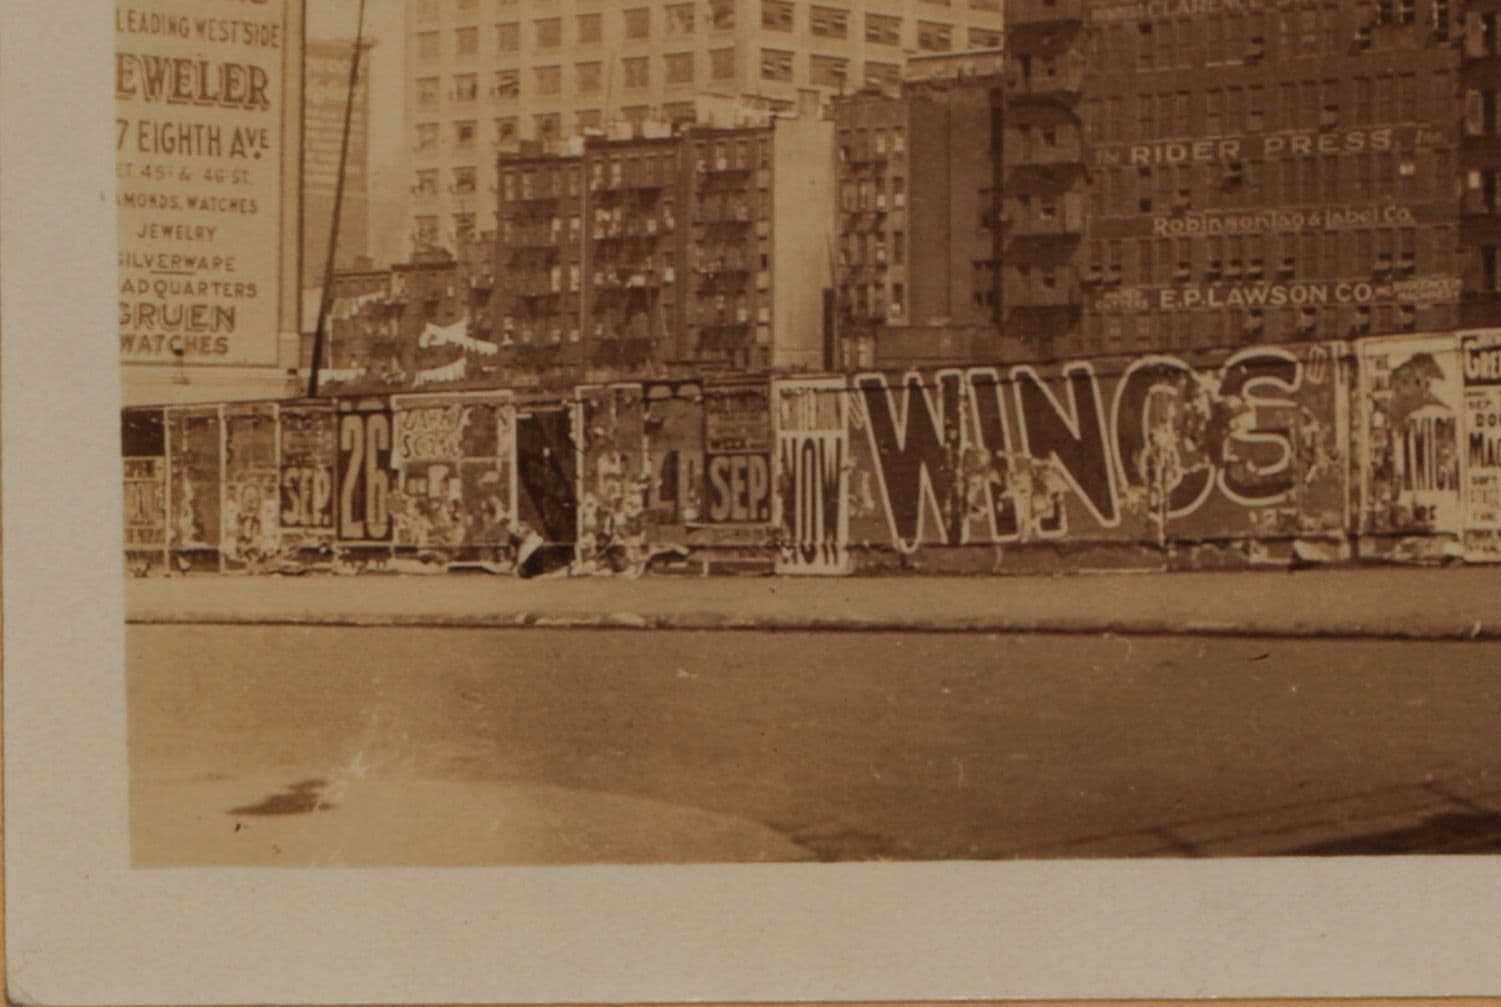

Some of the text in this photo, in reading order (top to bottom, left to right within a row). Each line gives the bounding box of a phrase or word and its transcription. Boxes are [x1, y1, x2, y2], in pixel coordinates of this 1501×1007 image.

[115, 7, 190, 39] LEADING
[116, 52, 271, 112] EWELER
[116, 117, 130, 151] 7
[138, 119, 222, 158] EIGHTH
[1129, 137, 1241, 166] RIDER
[178, 165, 192, 182] &
[186, 194, 259, 215] WATCHES
[1309, 209, 1322, 228] &
[136, 223, 217, 242] JEWELRY
[119, 332, 231, 358] WATCHES
[340, 413, 391, 540] 26
[709, 455, 769, 522] SEP.
[780, 437, 843, 565] NOW
